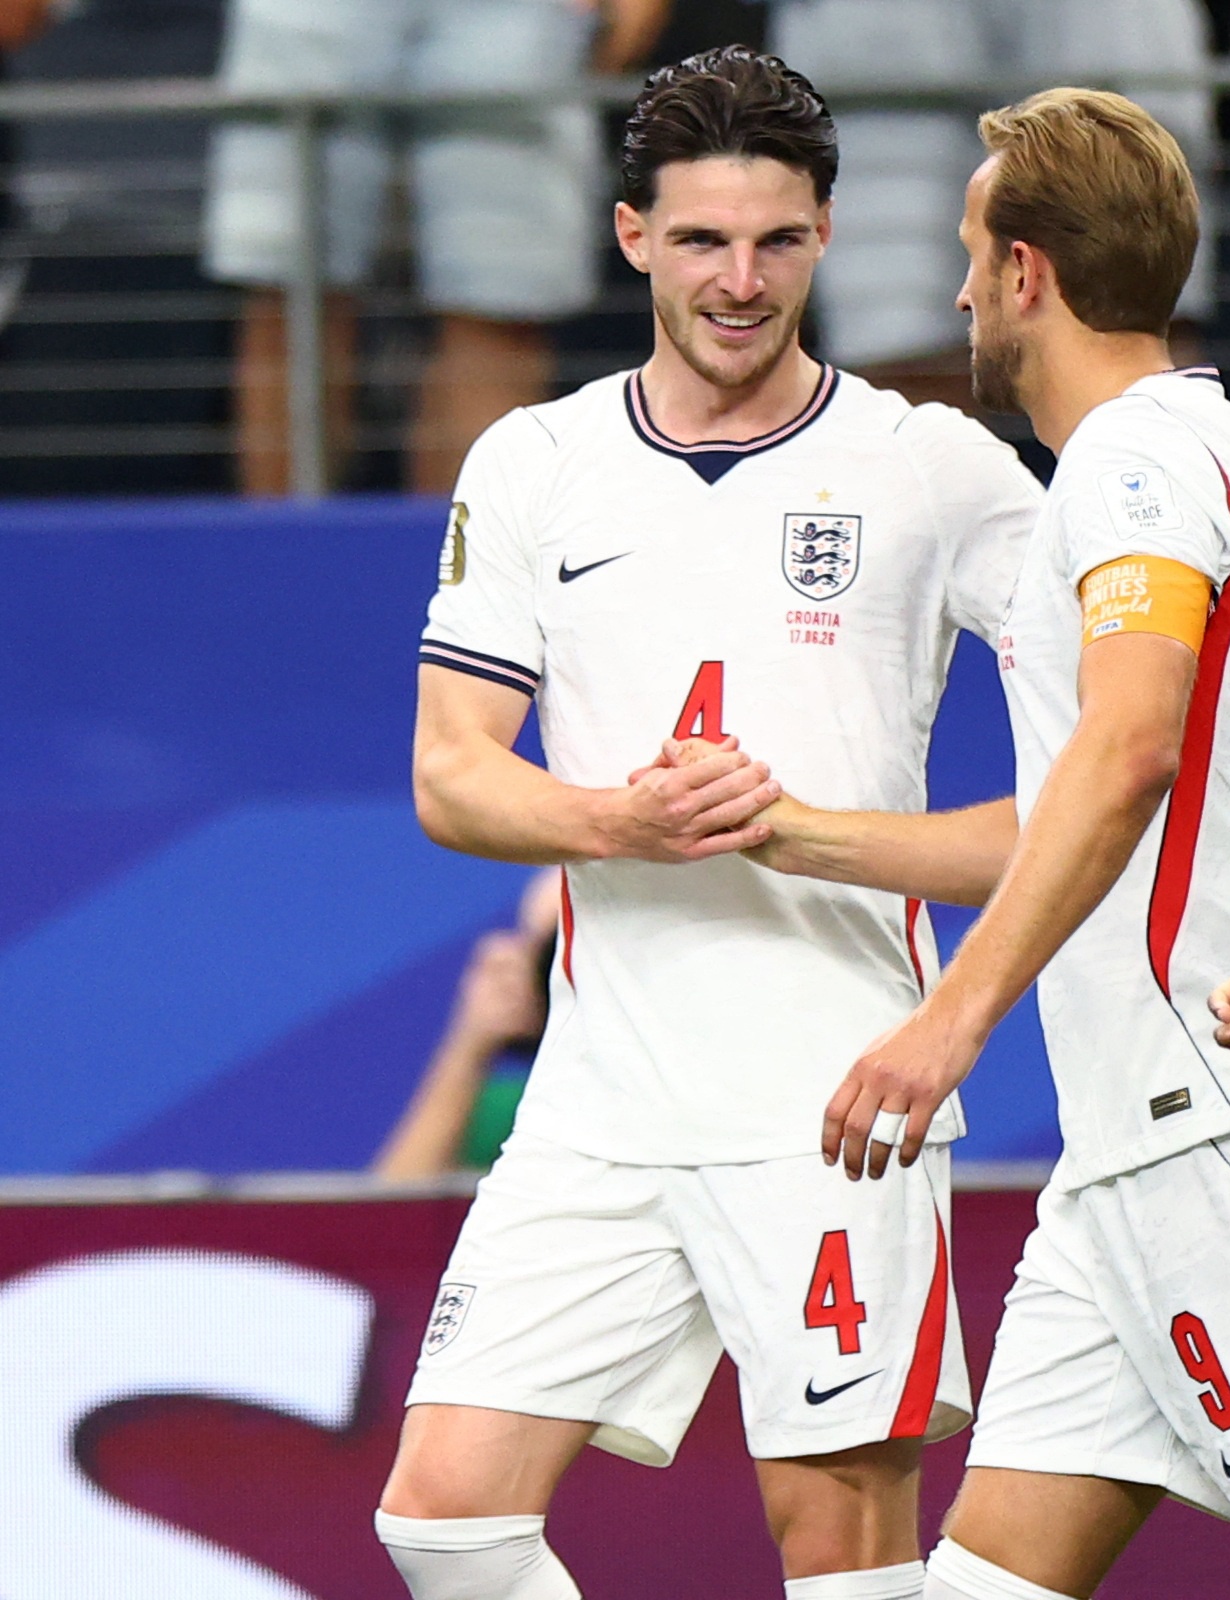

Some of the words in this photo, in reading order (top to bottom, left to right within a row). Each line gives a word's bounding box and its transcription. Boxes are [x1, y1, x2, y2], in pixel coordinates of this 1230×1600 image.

[1127, 504, 1165, 522] PEACE
[1084, 563, 1150, 594] FOOTBALL
[1083, 577, 1148, 613] UNITES
[786, 610, 841, 628] CROATIA
[1100, 596, 1152, 621] World
[789, 630, 836, 646] 17.06.26
[1095, 621, 1119, 634] FIFA
[804, 1229, 866, 1356] 4
